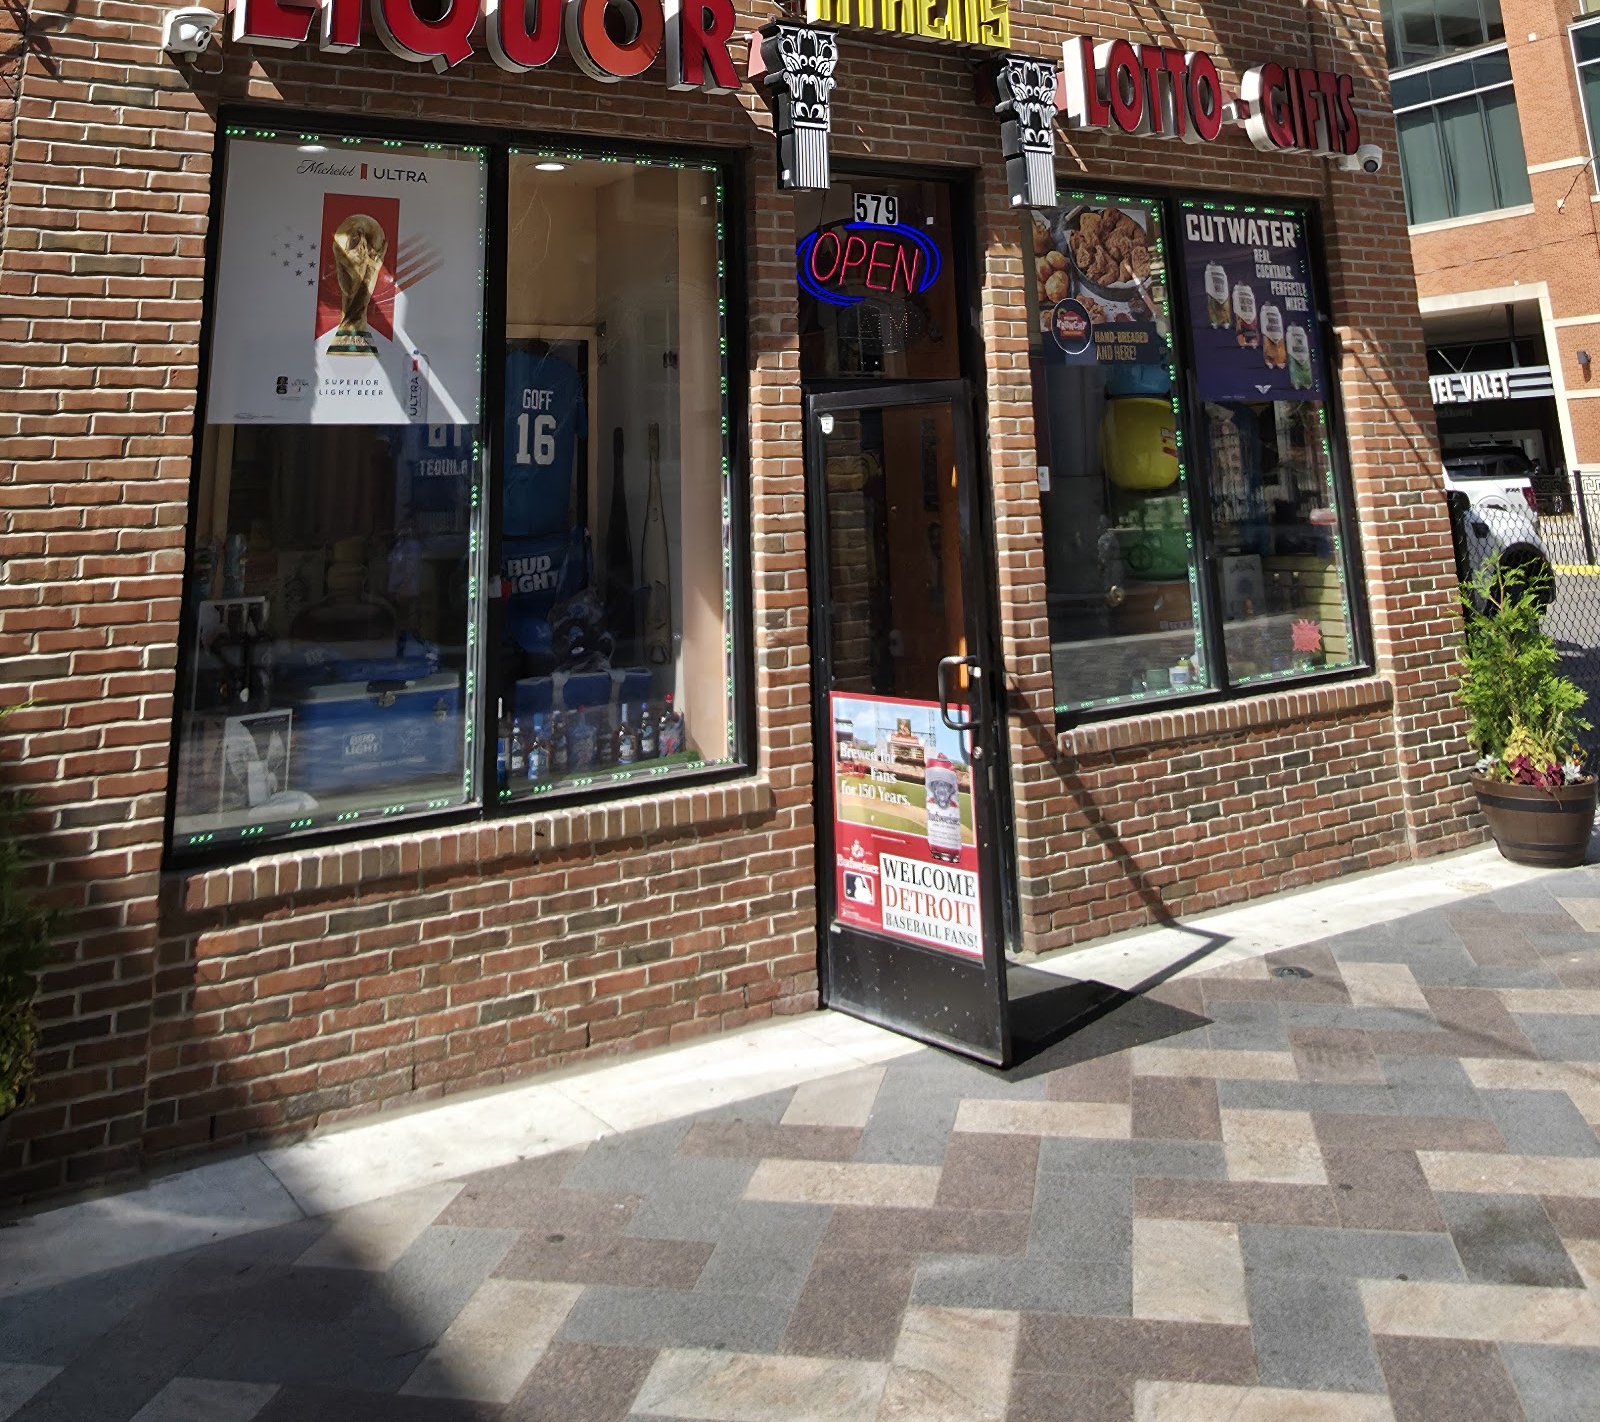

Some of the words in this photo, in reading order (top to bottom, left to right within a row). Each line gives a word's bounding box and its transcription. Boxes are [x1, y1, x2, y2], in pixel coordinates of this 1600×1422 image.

[1062, 36, 1223, 145] LOTTO
[1241, 62, 1360, 155] GIFTS
[373, 167, 429, 184] ULTRA
[855, 194, 898, 225] 579
[1185, 214, 1297, 248] CUTWATER
[811, 231, 919, 294] OPEN
[1096, 345, 1113, 360] AND
[324, 378, 379, 387] SUPERIOR
[409, 376, 420, 416] ULTRA
[1460, 372, 1510, 401] VALET
[522, 388, 554, 411] GOFF
[515, 413, 558, 466] 16
[419, 459, 468, 476] TEQUILA
[507, 555, 552, 576] BUD
[511, 570, 560, 594] IGHT
[840, 742, 878, 761] Brewed
[880, 750, 896, 764] for
[870, 766, 897, 784] Fans
[841, 780, 857, 795] for
[859, 783, 876, 800] 150
[878, 786, 911, 806] Years.
[883, 857, 976, 898] WELCOME
[884, 884, 976, 927] DETROIT
[885, 912, 942, 940] BASEBALL
[944, 924, 979, 949] FANS!
